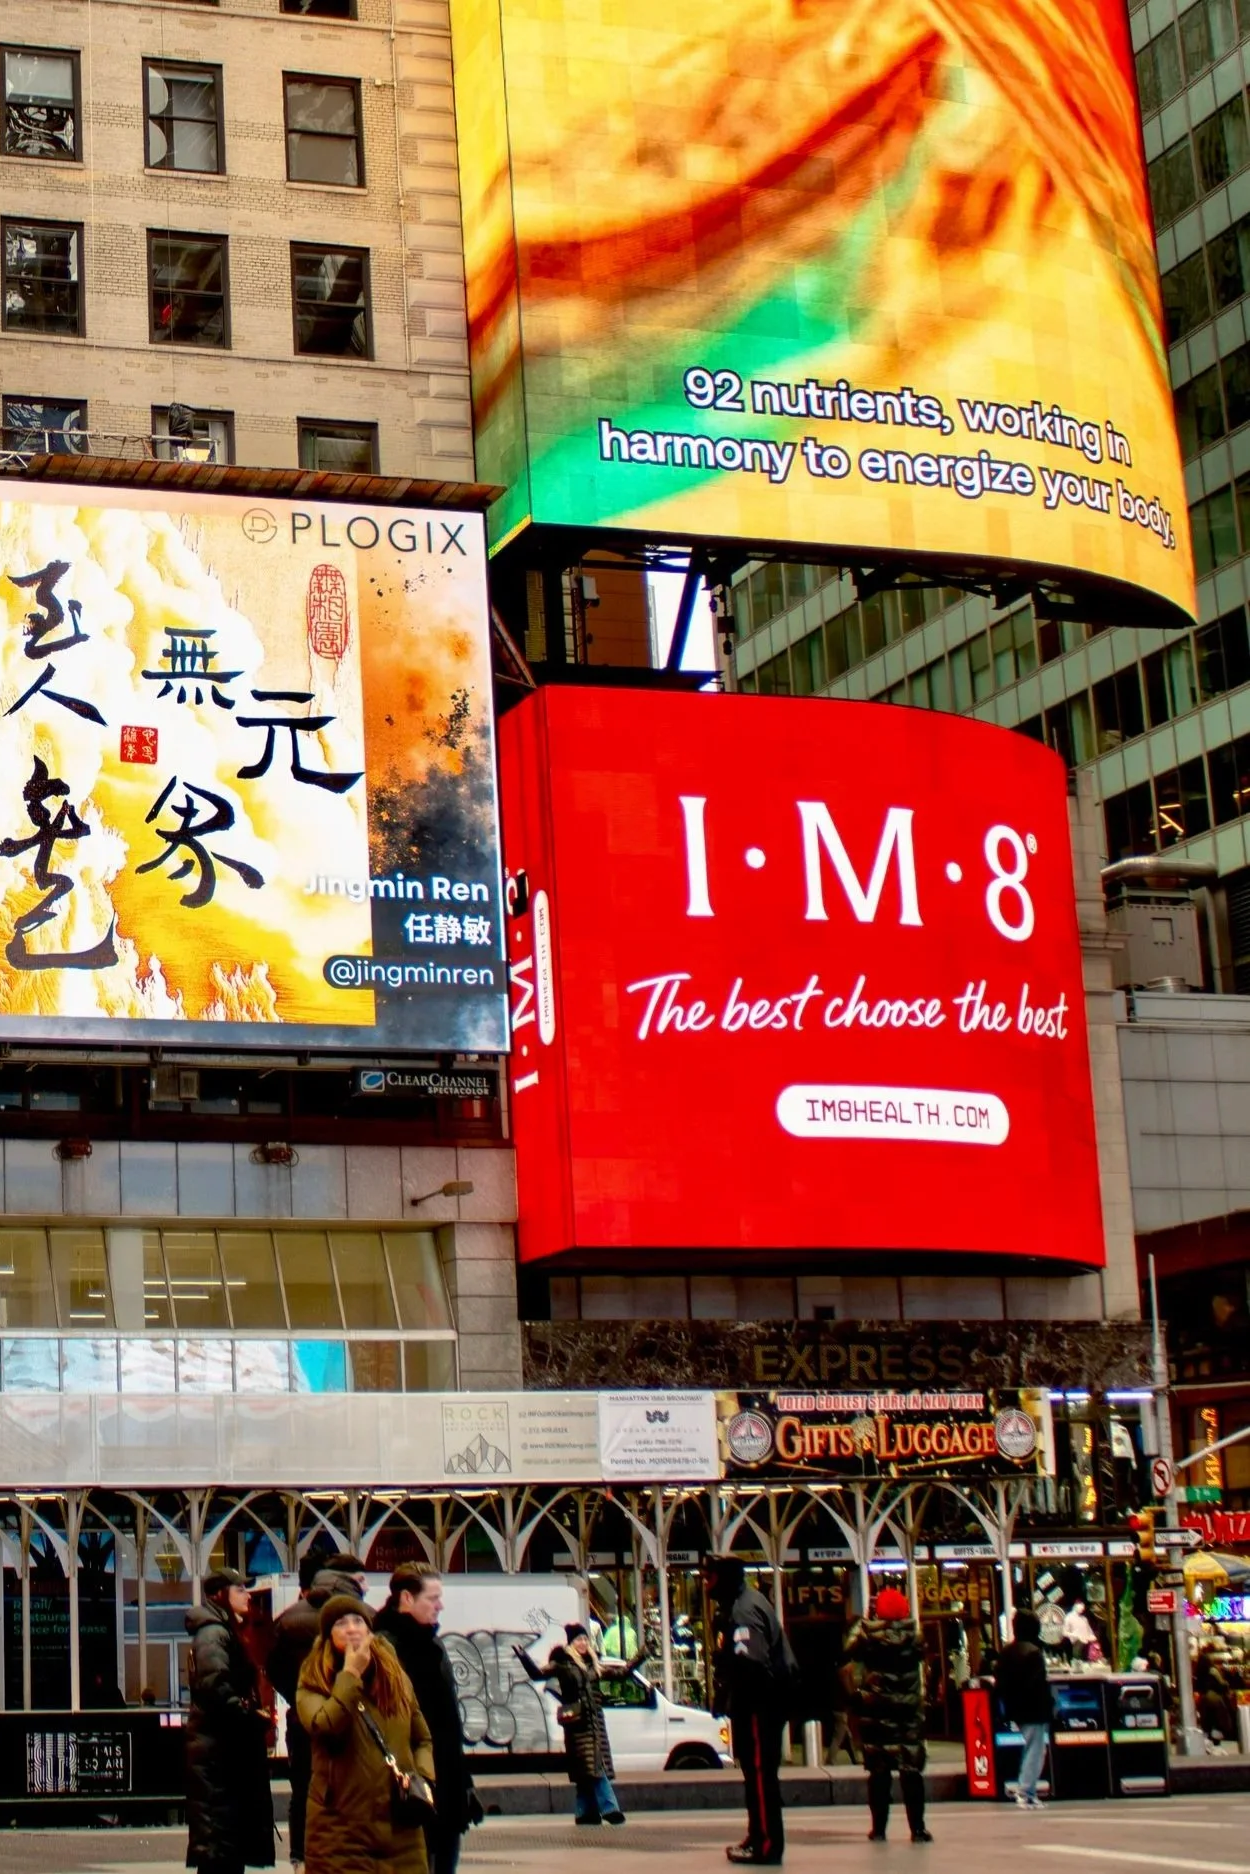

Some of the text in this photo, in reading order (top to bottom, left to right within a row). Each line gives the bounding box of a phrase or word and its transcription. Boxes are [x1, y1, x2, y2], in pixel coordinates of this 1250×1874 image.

[685, 366, 1131, 467] 92 nutrients, working in
[599, 418, 797, 484] harmony
[802, 438, 852, 479] to
[859, 450, 1036, 497] energize
[1042, 465, 1113, 510] your
[292, 513, 468, 556] PLOGIX
[305, 873, 490, 902] Jingmin Ren
[405, 913, 492, 947] 任静敏
[328, 960, 495, 987] @jingminren
[626, 972, 1069, 1040] The best choose the best
[428, 1086, 489, 1095] SPECTACOLOR
[805, 1098, 991, 1130] IM8HEALTH.COM
[753, 1344, 964, 1382] EXPRESS
[445, 1407, 504, 1421] ROCK
[777, 1394, 984, 1411] VOTED COOLEST STORE IN NEW YORK
[775, 1416, 854, 1460] GIFTS
[875, 1415, 996, 1460] LUGGAGE
